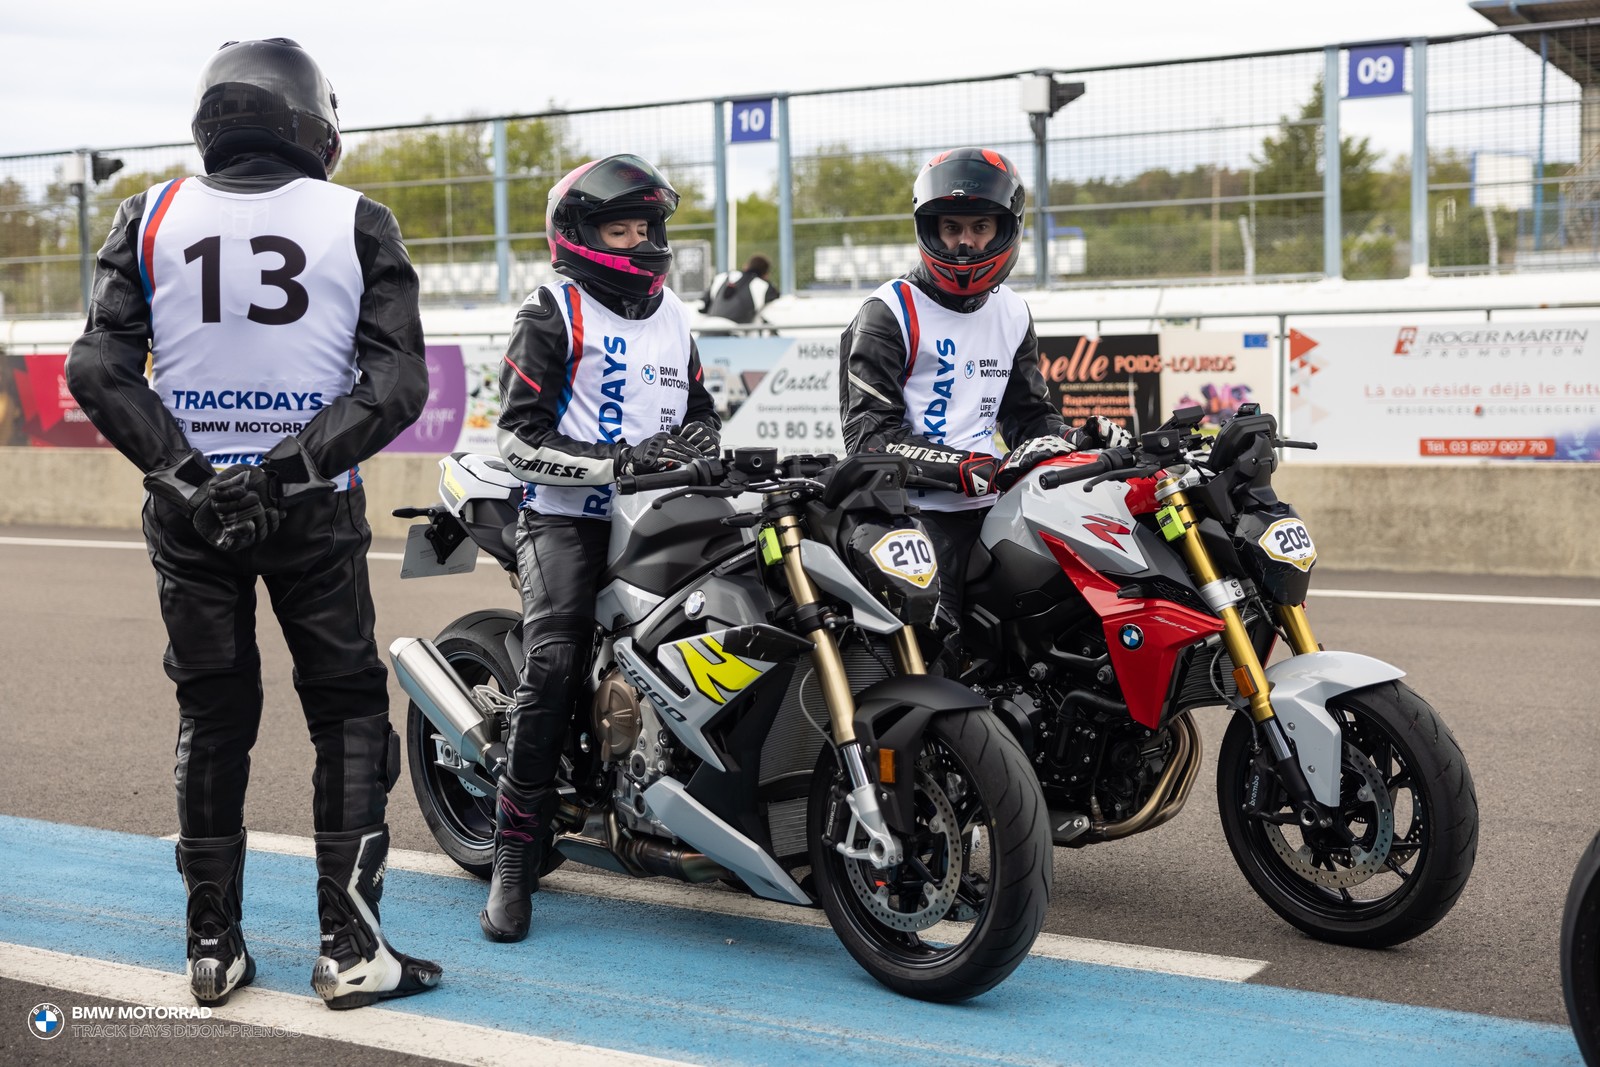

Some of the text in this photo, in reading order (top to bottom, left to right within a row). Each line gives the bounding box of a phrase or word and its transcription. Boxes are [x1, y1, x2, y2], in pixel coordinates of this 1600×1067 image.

[1357, 55, 1395, 85] 09
[738, 108, 765, 132] 10
[184, 235, 309, 325] 13
[1427, 327, 1588, 345] ROGER MARTIN
[1422, 346, 1584, 358] PROMOTION
[660, 366, 678, 377] BMW
[660, 377, 690, 391] MOTORRA
[1538, 381, 1556, 397] le
[172, 390, 323, 411] TRACKDAYS
[661, 408, 676, 416] MAKE
[191, 421, 309, 434] BMW MOTORRA
[757, 421, 835, 439] 03 80 56
[1274, 526, 1311, 554] 209
[888, 539, 932, 567] 210
[1248, 775, 1260, 807] brembo
[200, 938, 218, 946] BMW
